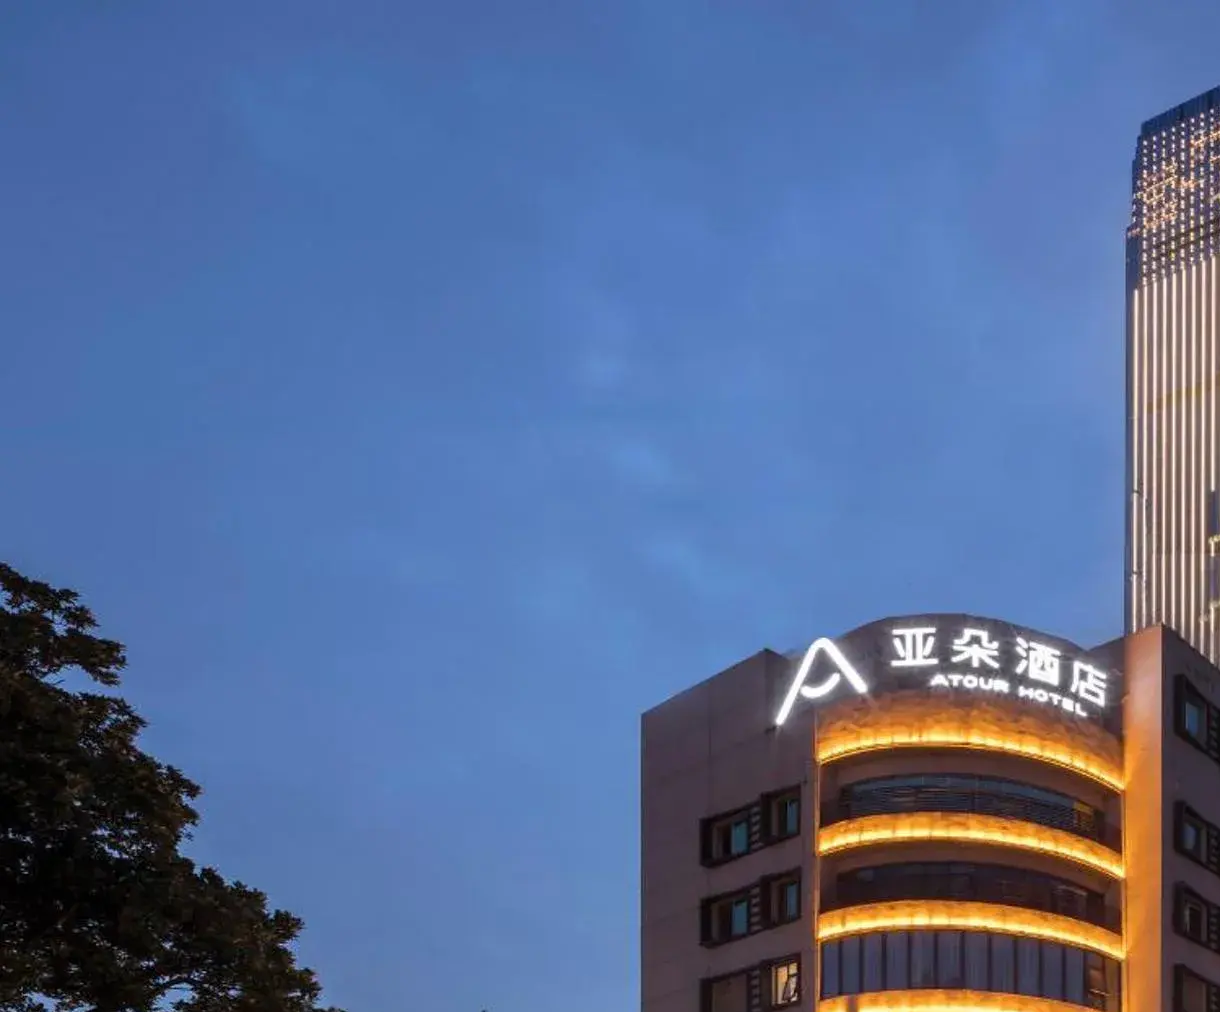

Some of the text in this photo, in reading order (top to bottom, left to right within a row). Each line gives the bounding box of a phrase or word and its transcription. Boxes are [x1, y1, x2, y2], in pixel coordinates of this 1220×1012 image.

[891, 627, 1107, 707] 亚朵酒店
[930, 673, 1088, 717] ATOUR HOTEL
